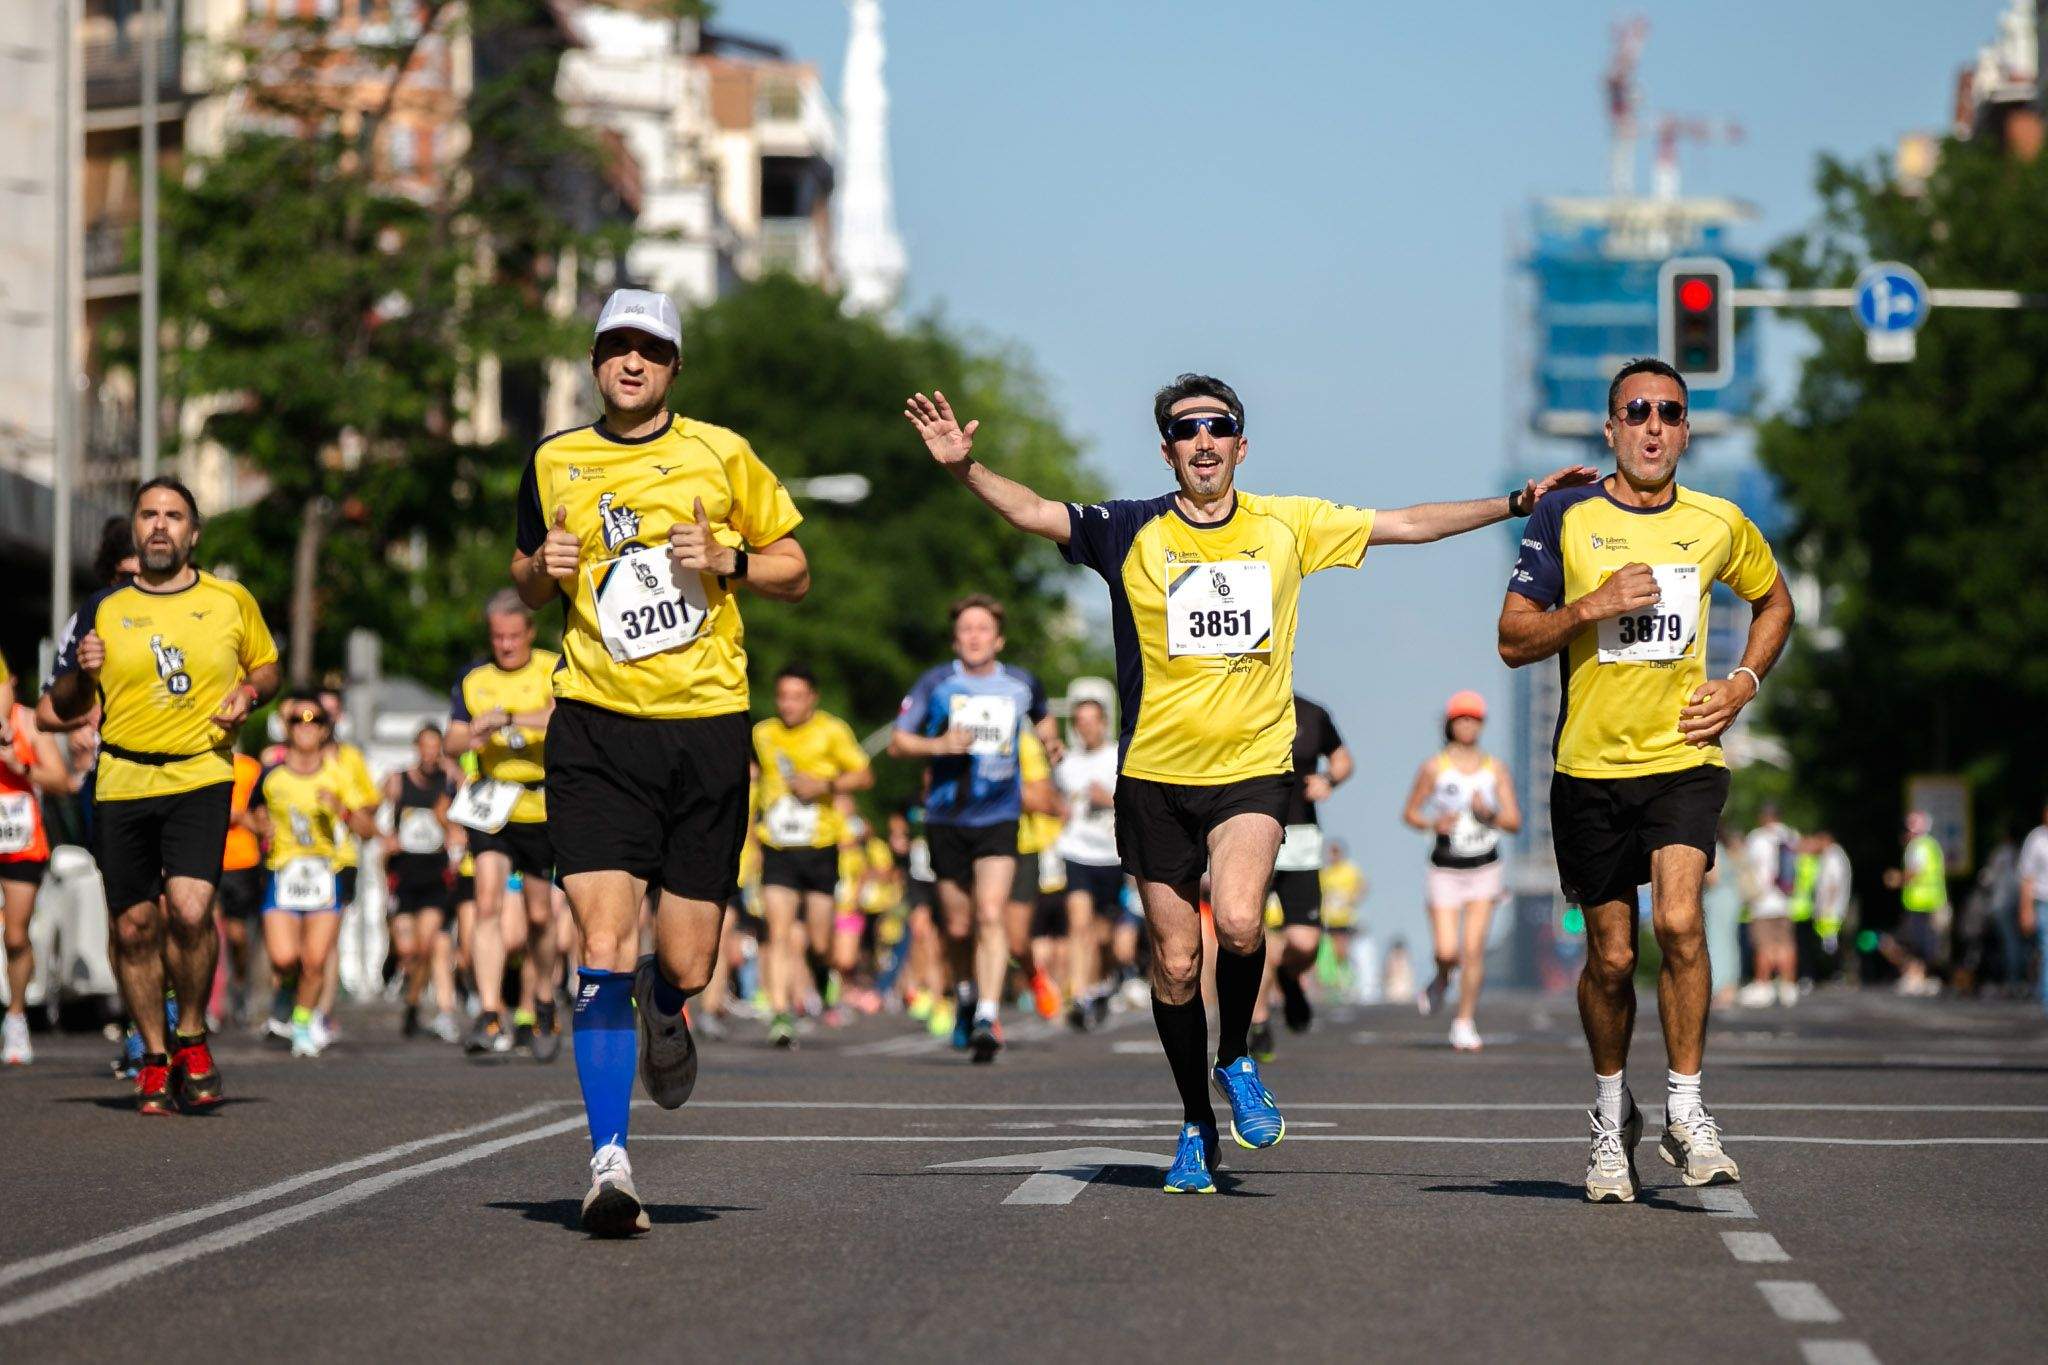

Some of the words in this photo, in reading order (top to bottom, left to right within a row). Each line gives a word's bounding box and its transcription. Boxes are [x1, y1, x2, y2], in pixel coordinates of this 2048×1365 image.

[1606, 537, 1627, 545] Liberty
[1178, 551, 1198, 559] Liberty
[621, 595, 690, 640] 3201
[1189, 609, 1252, 638] 3851
[1618, 614, 1681, 644] 3879
[172, 675, 189, 692] 13
